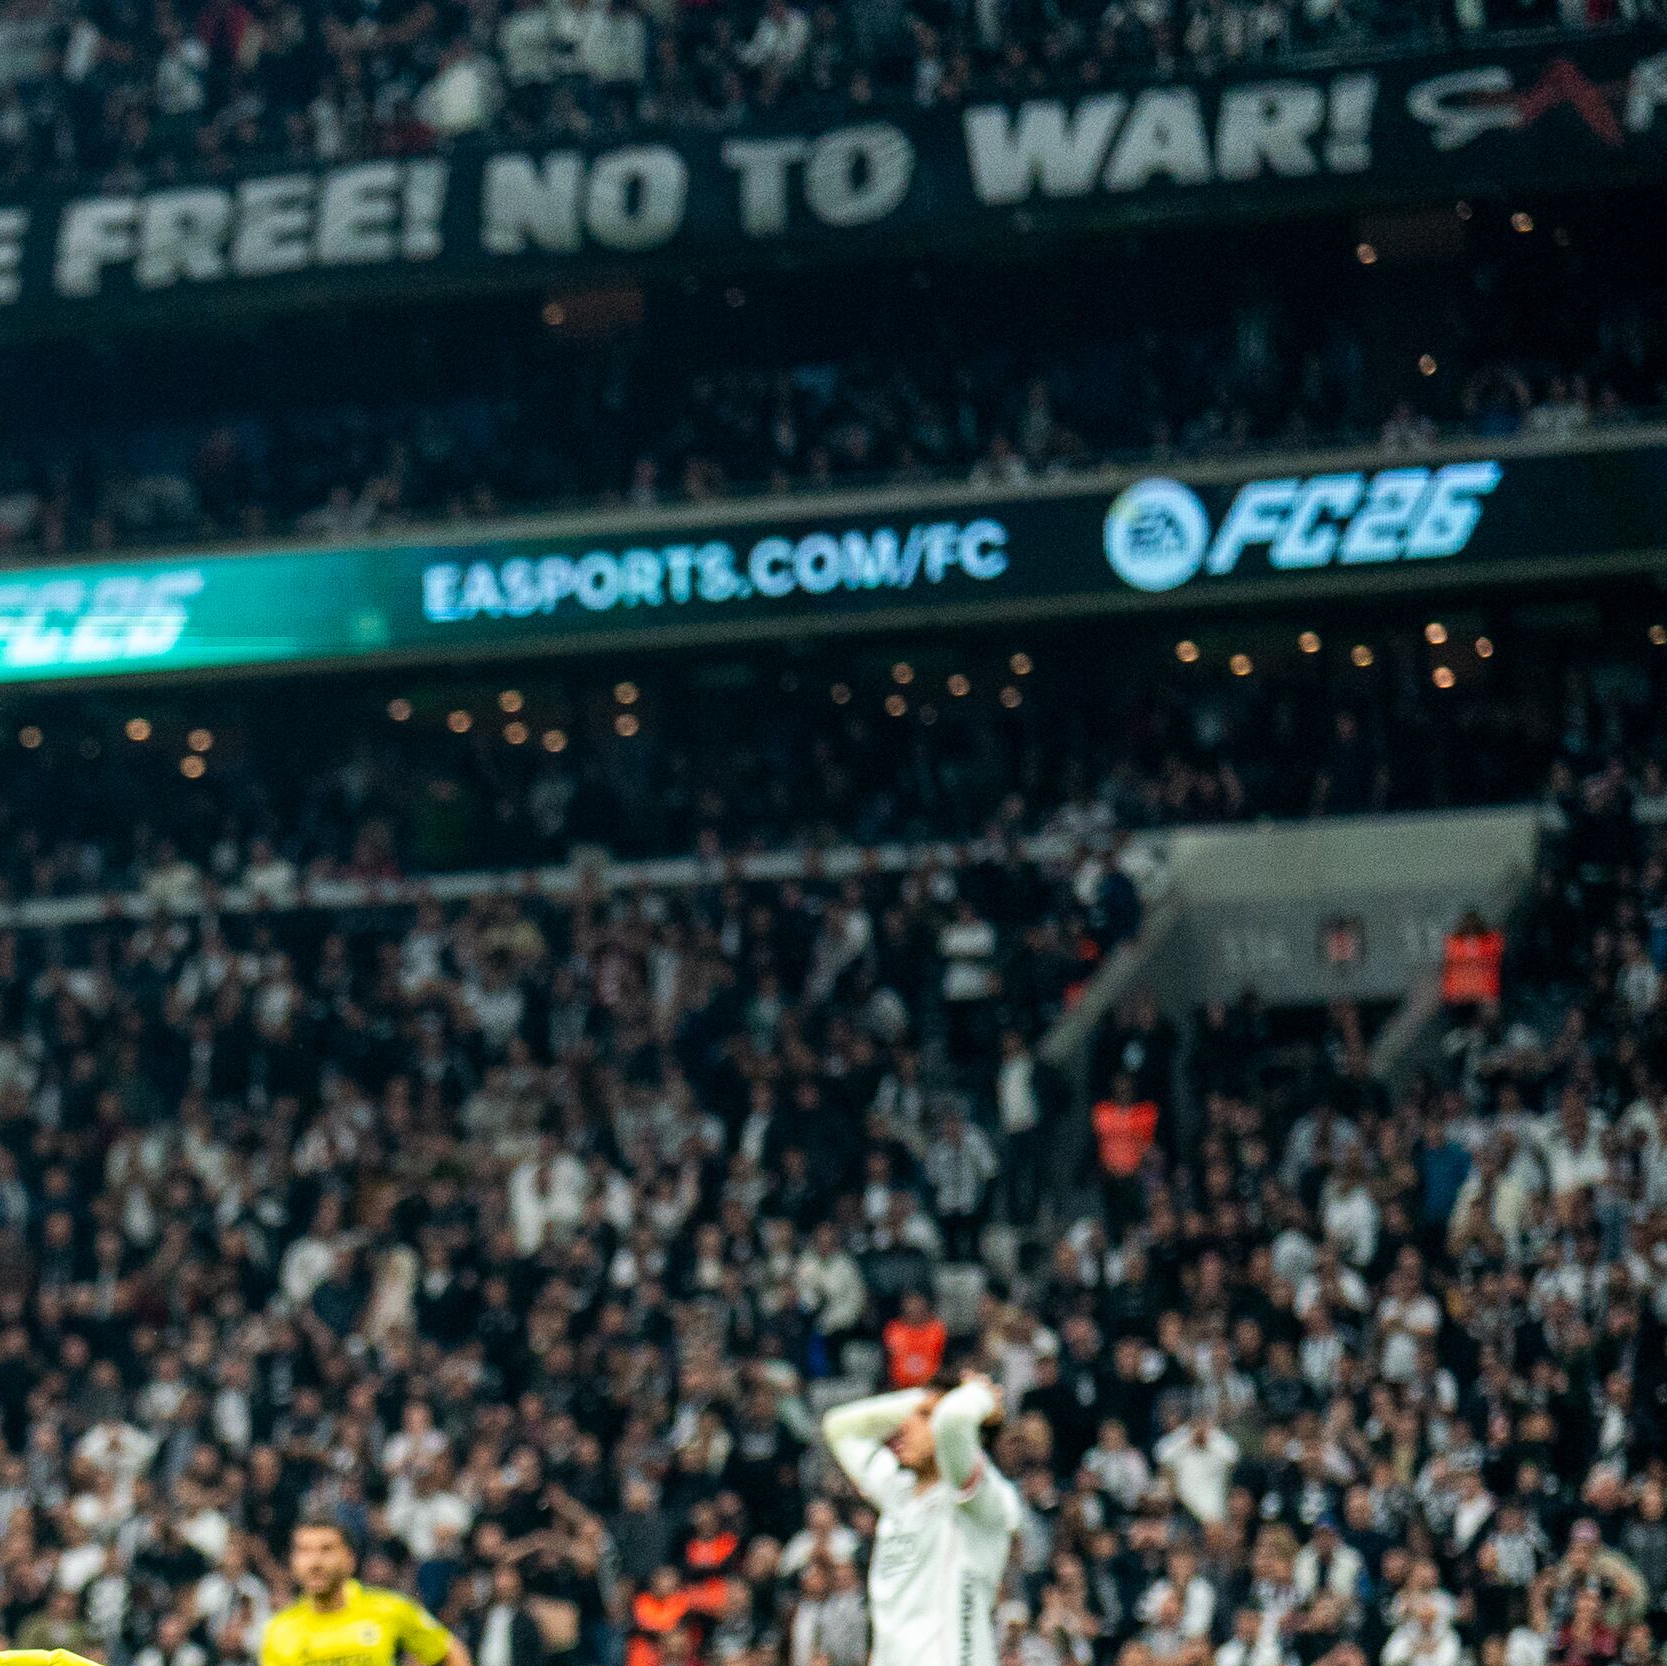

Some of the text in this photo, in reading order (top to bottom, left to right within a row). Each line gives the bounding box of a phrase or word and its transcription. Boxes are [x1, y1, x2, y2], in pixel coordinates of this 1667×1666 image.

[54, 159, 447, 298] FREE!
[483, 74, 1378, 256] NO TO WAR!
[422, 519, 1009, 622] EASPORTS.COM/FC
